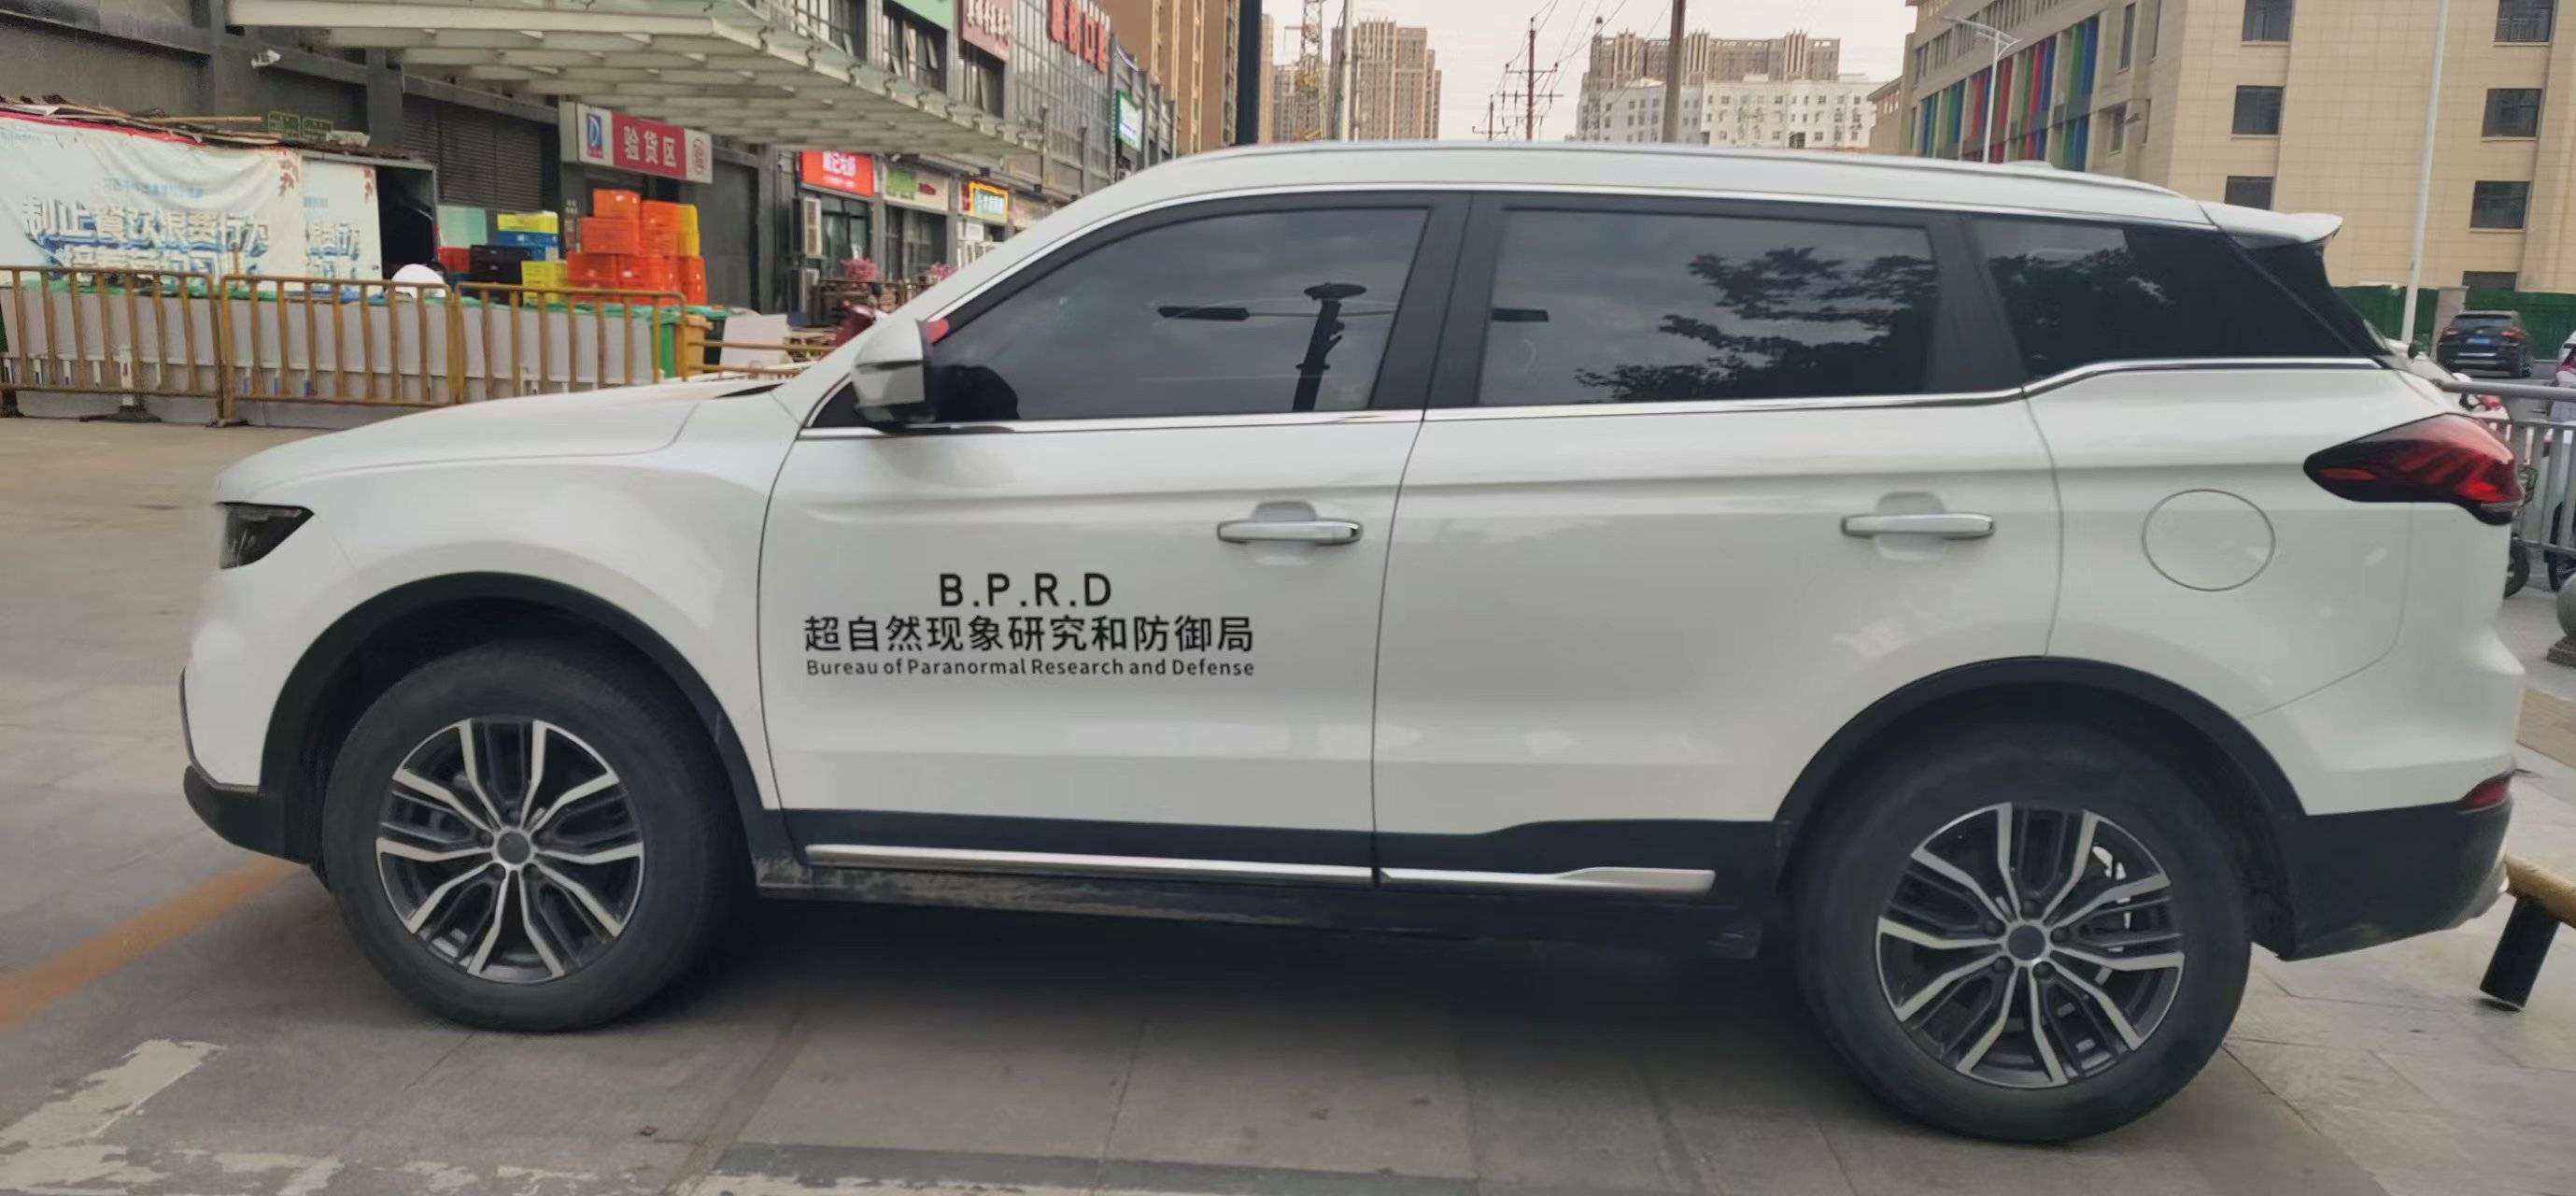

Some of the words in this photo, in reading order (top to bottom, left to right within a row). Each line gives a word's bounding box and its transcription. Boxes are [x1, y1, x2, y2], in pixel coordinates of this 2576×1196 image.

[623, 125, 677, 167] 验货区
[940, 573, 1111, 607] B.P.R.D
[804, 615, 1253, 653] 超自然现象研究和防御局
[806, 659, 878, 676] Bureau
[883, 658, 903, 675] of
[907, 658, 1026, 675] Paranormal
[1031, 658, 1125, 676] Research
[1128, 658, 1167, 676] and
[1171, 658, 1254, 676] Defense
